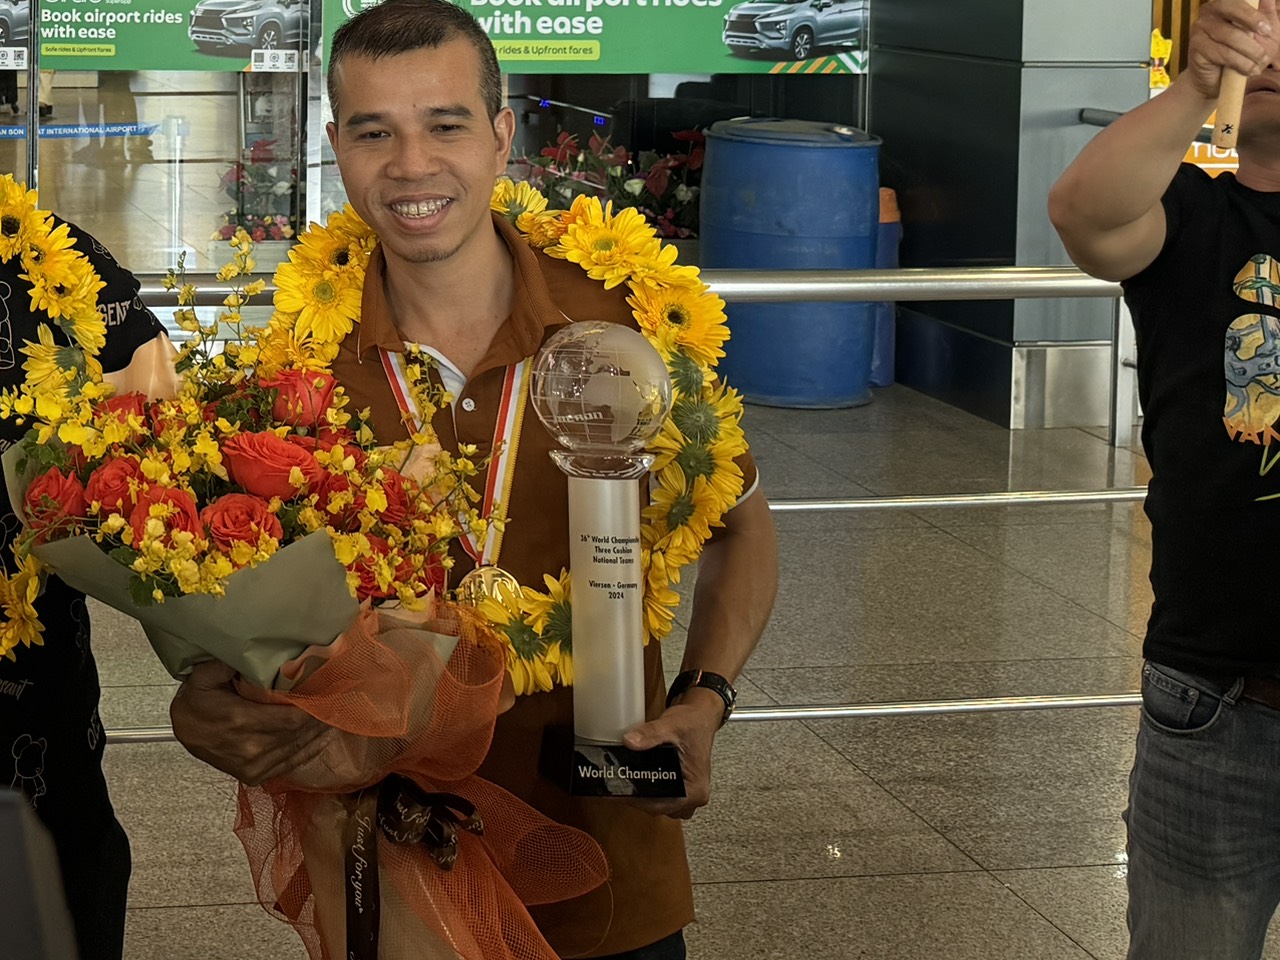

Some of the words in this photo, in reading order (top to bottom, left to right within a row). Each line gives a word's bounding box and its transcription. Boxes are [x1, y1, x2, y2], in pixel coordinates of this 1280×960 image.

[41, 8, 82, 23] Book
[84, 9, 141, 26] airport
[143, 10, 183, 24] rides
[536, 16, 603, 34] ease
[41, 25, 75, 39] with
[78, 27, 116, 39] ease
[498, 46, 521, 54] rides
[523, 46, 530, 54] &
[531, 46, 567, 56] Upfront
[569, 46, 593, 54] fares
[105, 126, 137, 134] AIRPORT
[591, 536, 610, 544] World
[594, 546, 611, 554] Three
[613, 547, 633, 555] Cushion
[593, 556, 618, 564] National
[608, 592, 625, 600] 2024
[578, 765, 614, 778] World
[618, 766, 677, 783] Champion
